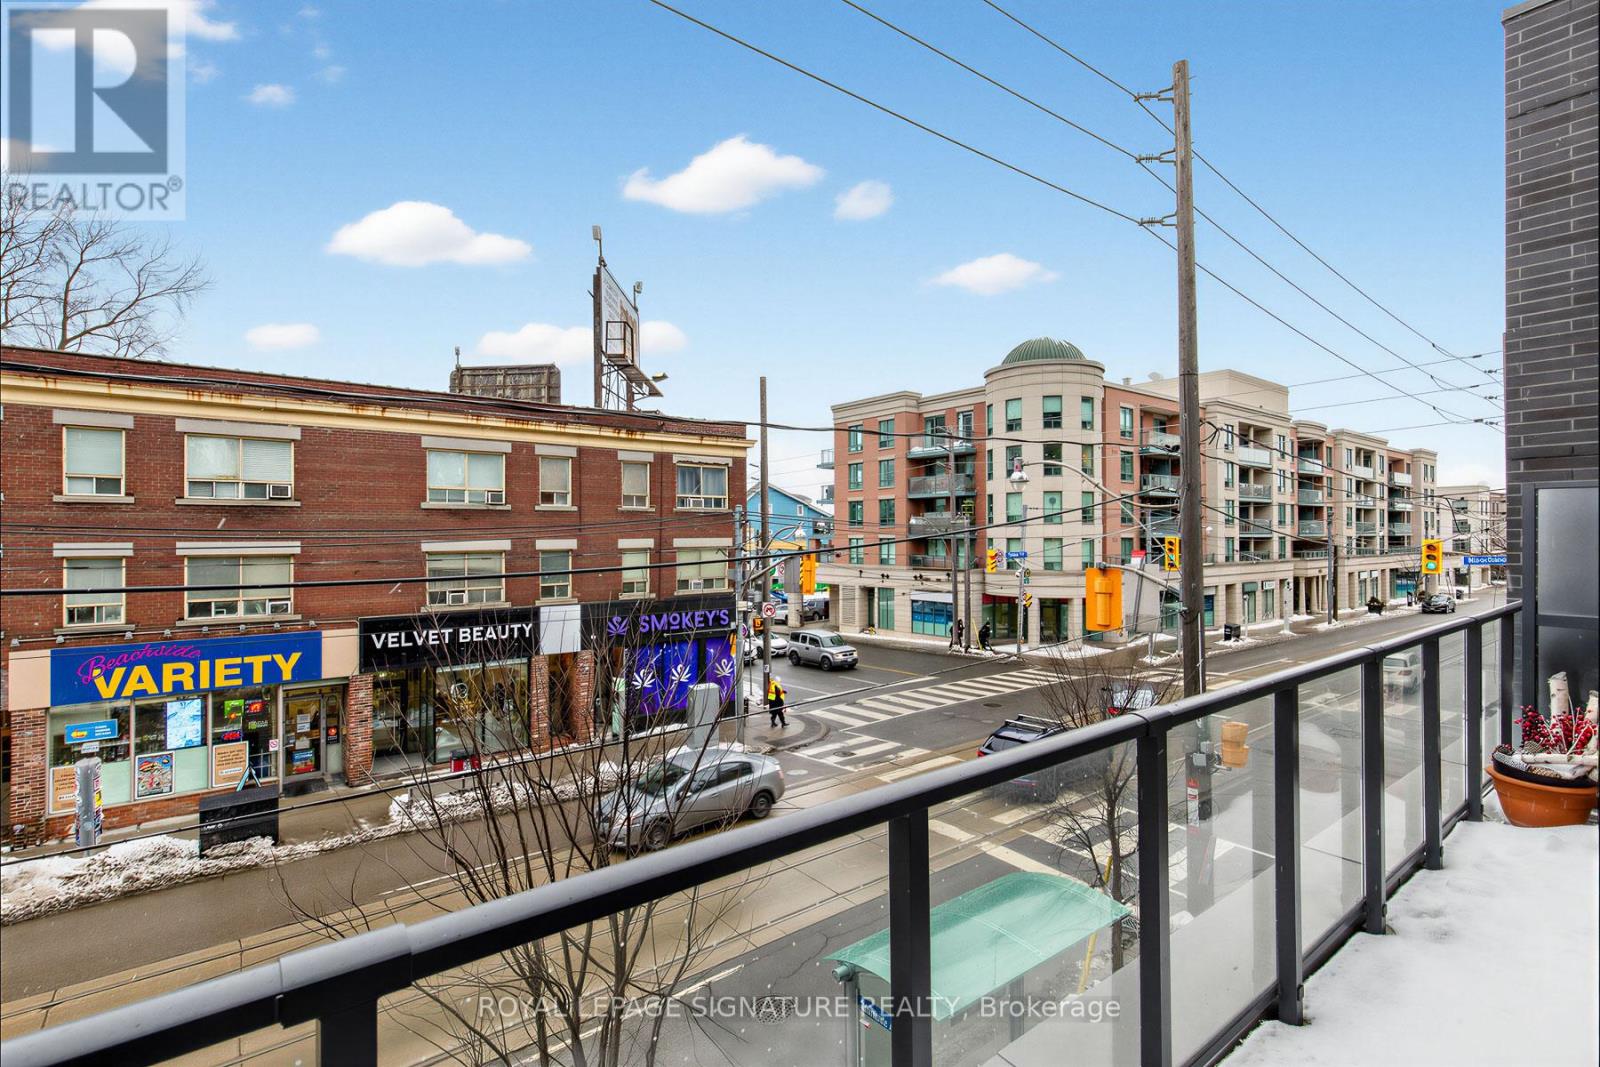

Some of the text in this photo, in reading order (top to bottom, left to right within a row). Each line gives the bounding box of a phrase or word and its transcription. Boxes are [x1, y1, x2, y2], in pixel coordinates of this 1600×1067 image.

[371, 623, 533, 649] VELVET BEAUTY
[639, 609, 729, 633] SMOKEY'S
[77, 643, 202, 685] Beachside
[92, 652, 302, 699] VARIETY
